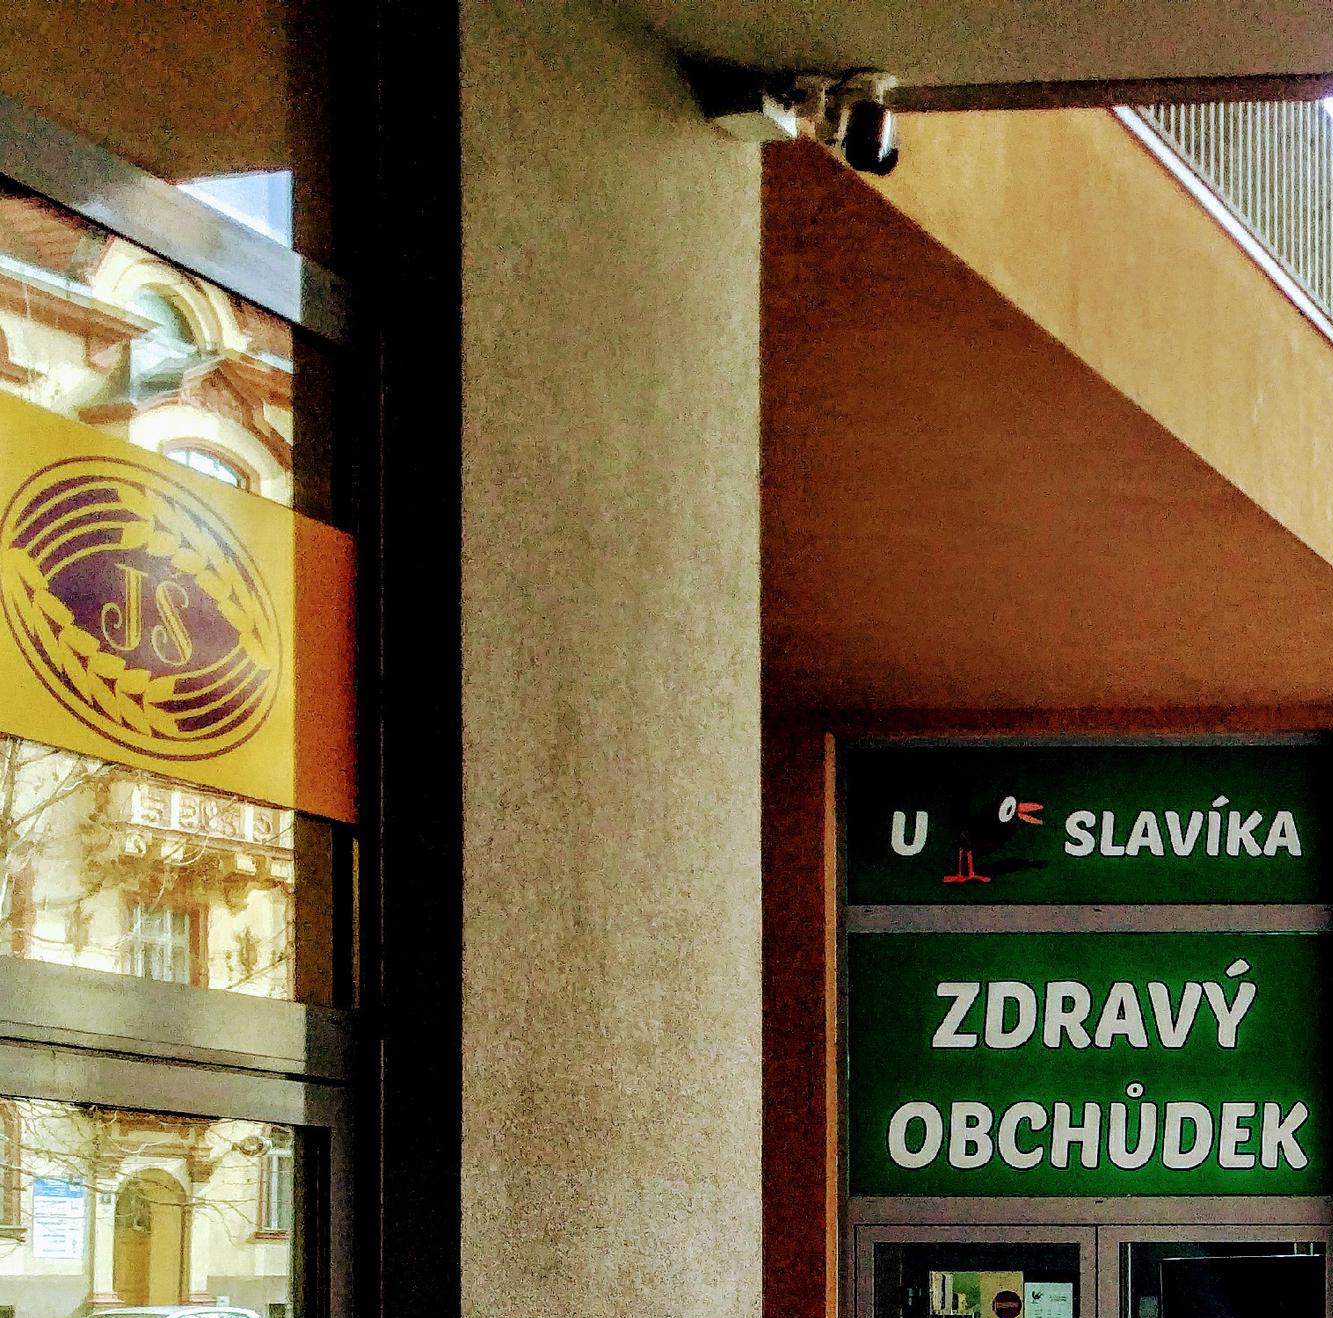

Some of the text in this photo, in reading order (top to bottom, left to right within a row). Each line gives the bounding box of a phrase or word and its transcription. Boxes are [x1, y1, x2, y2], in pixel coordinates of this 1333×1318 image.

[101, 563, 193, 667] JS
[890, 795, 1303, 857] U SLAVÍKA
[930, 958, 1257, 1049] ZDRAVÝ
[887, 1080, 1310, 1170] OBCHŮDEK
